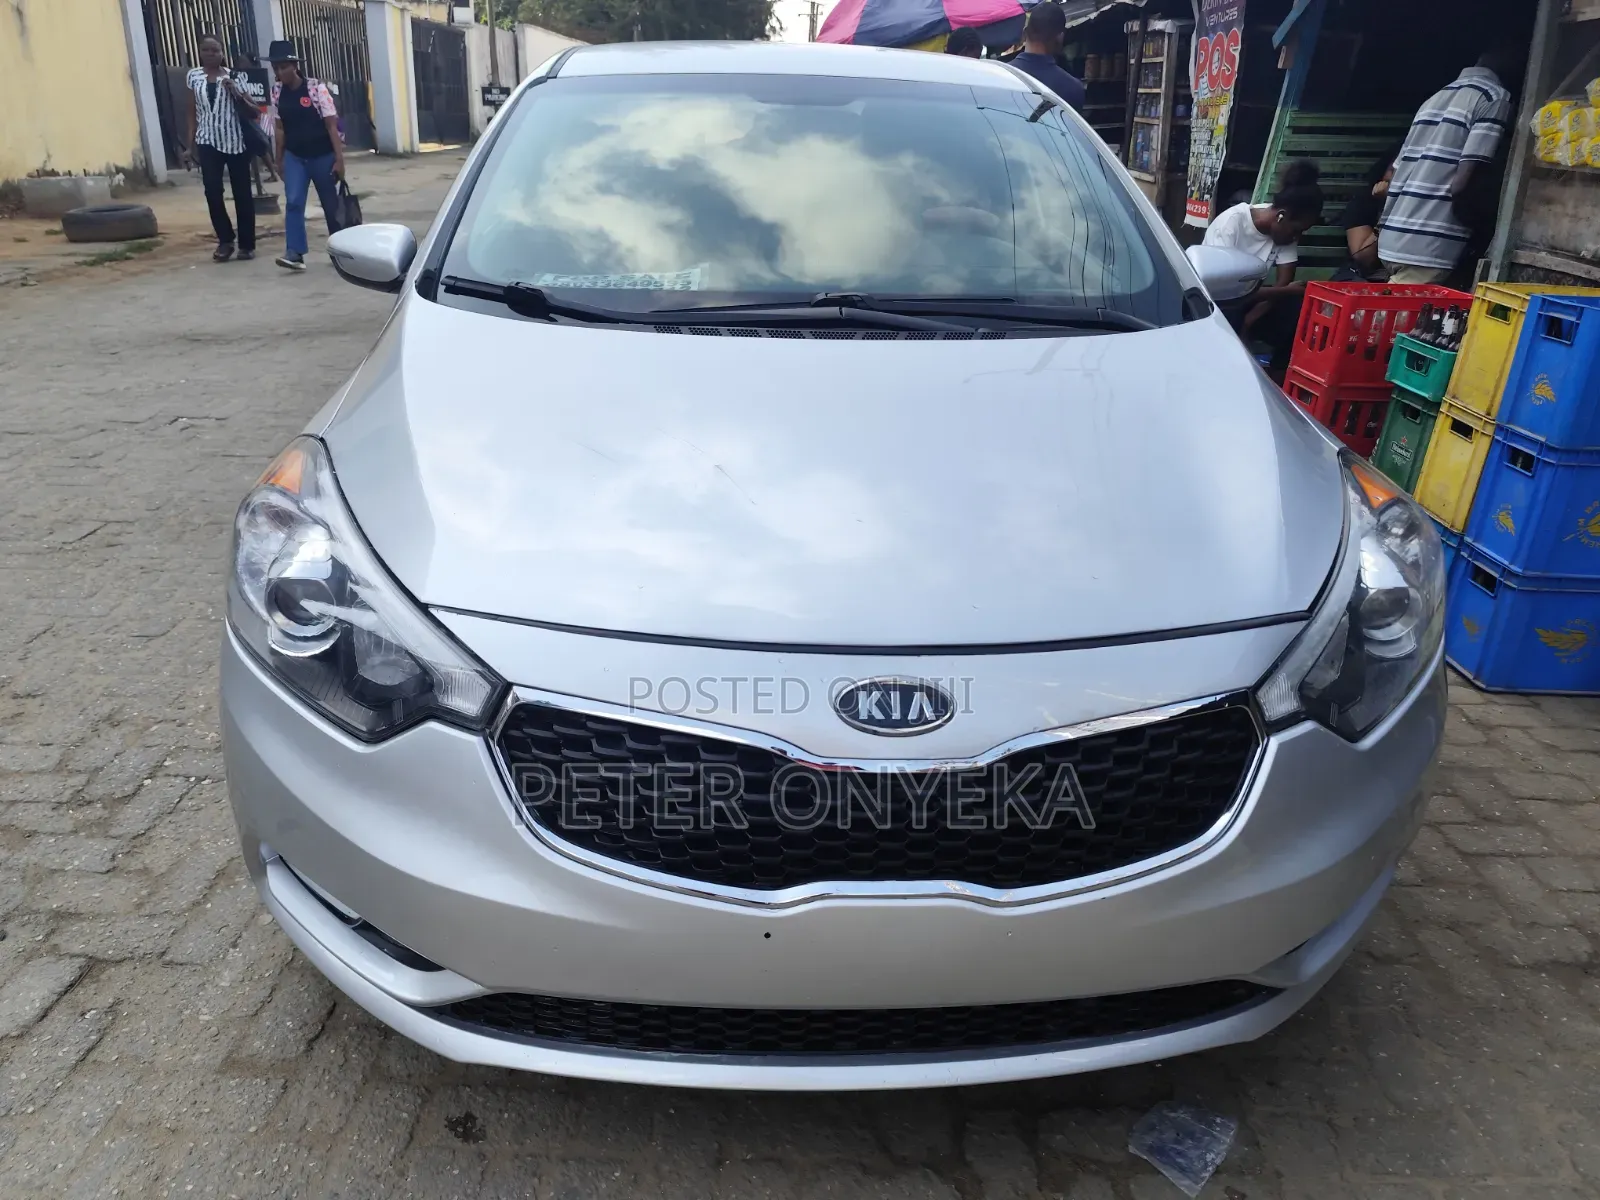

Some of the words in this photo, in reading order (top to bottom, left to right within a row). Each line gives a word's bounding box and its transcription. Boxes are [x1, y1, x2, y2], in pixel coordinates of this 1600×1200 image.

[1205, 7, 1238, 27] VENTURES
[1193, 27, 1240, 93] POS
[857, 690, 937, 721] KIA
